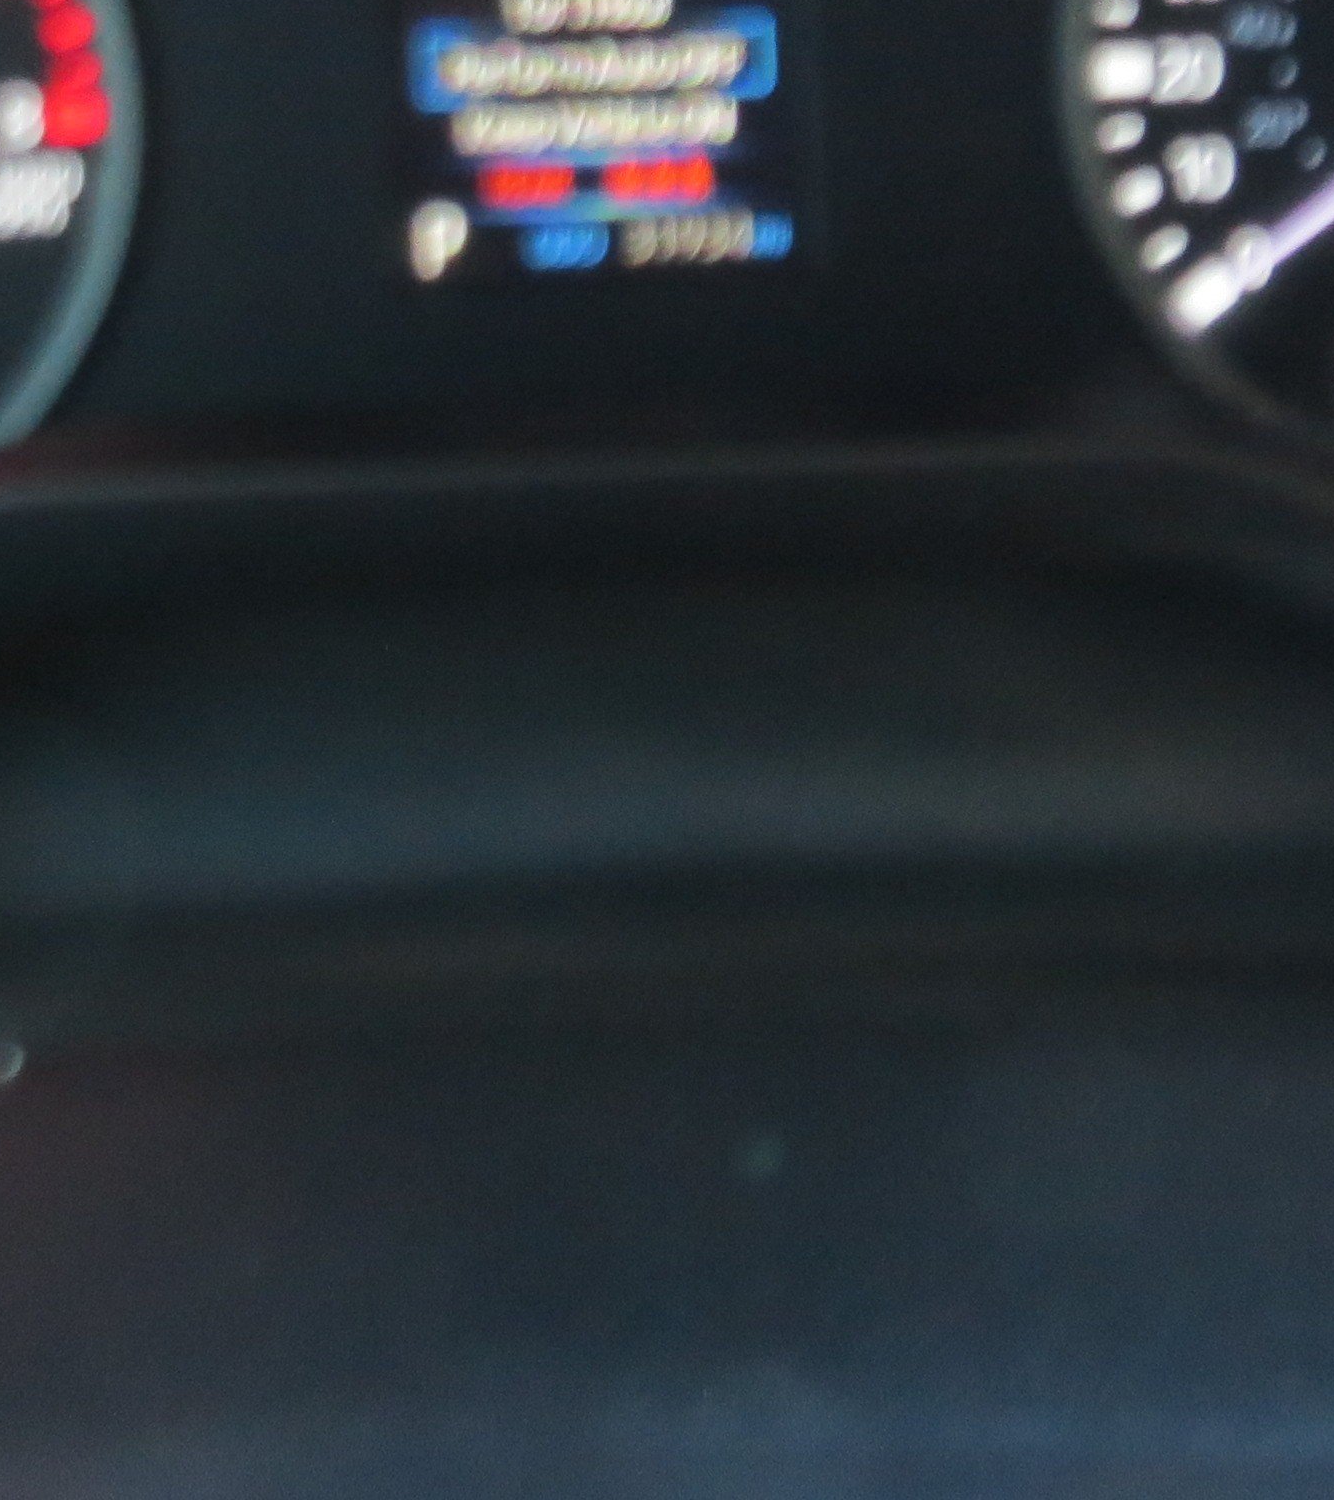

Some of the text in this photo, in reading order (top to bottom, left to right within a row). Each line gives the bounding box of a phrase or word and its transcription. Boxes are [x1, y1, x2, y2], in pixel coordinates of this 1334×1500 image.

[1152, 33, 1224, 103] 20
[1165, 134, 1235, 204] 10
[410, 200, 467, 281] P
